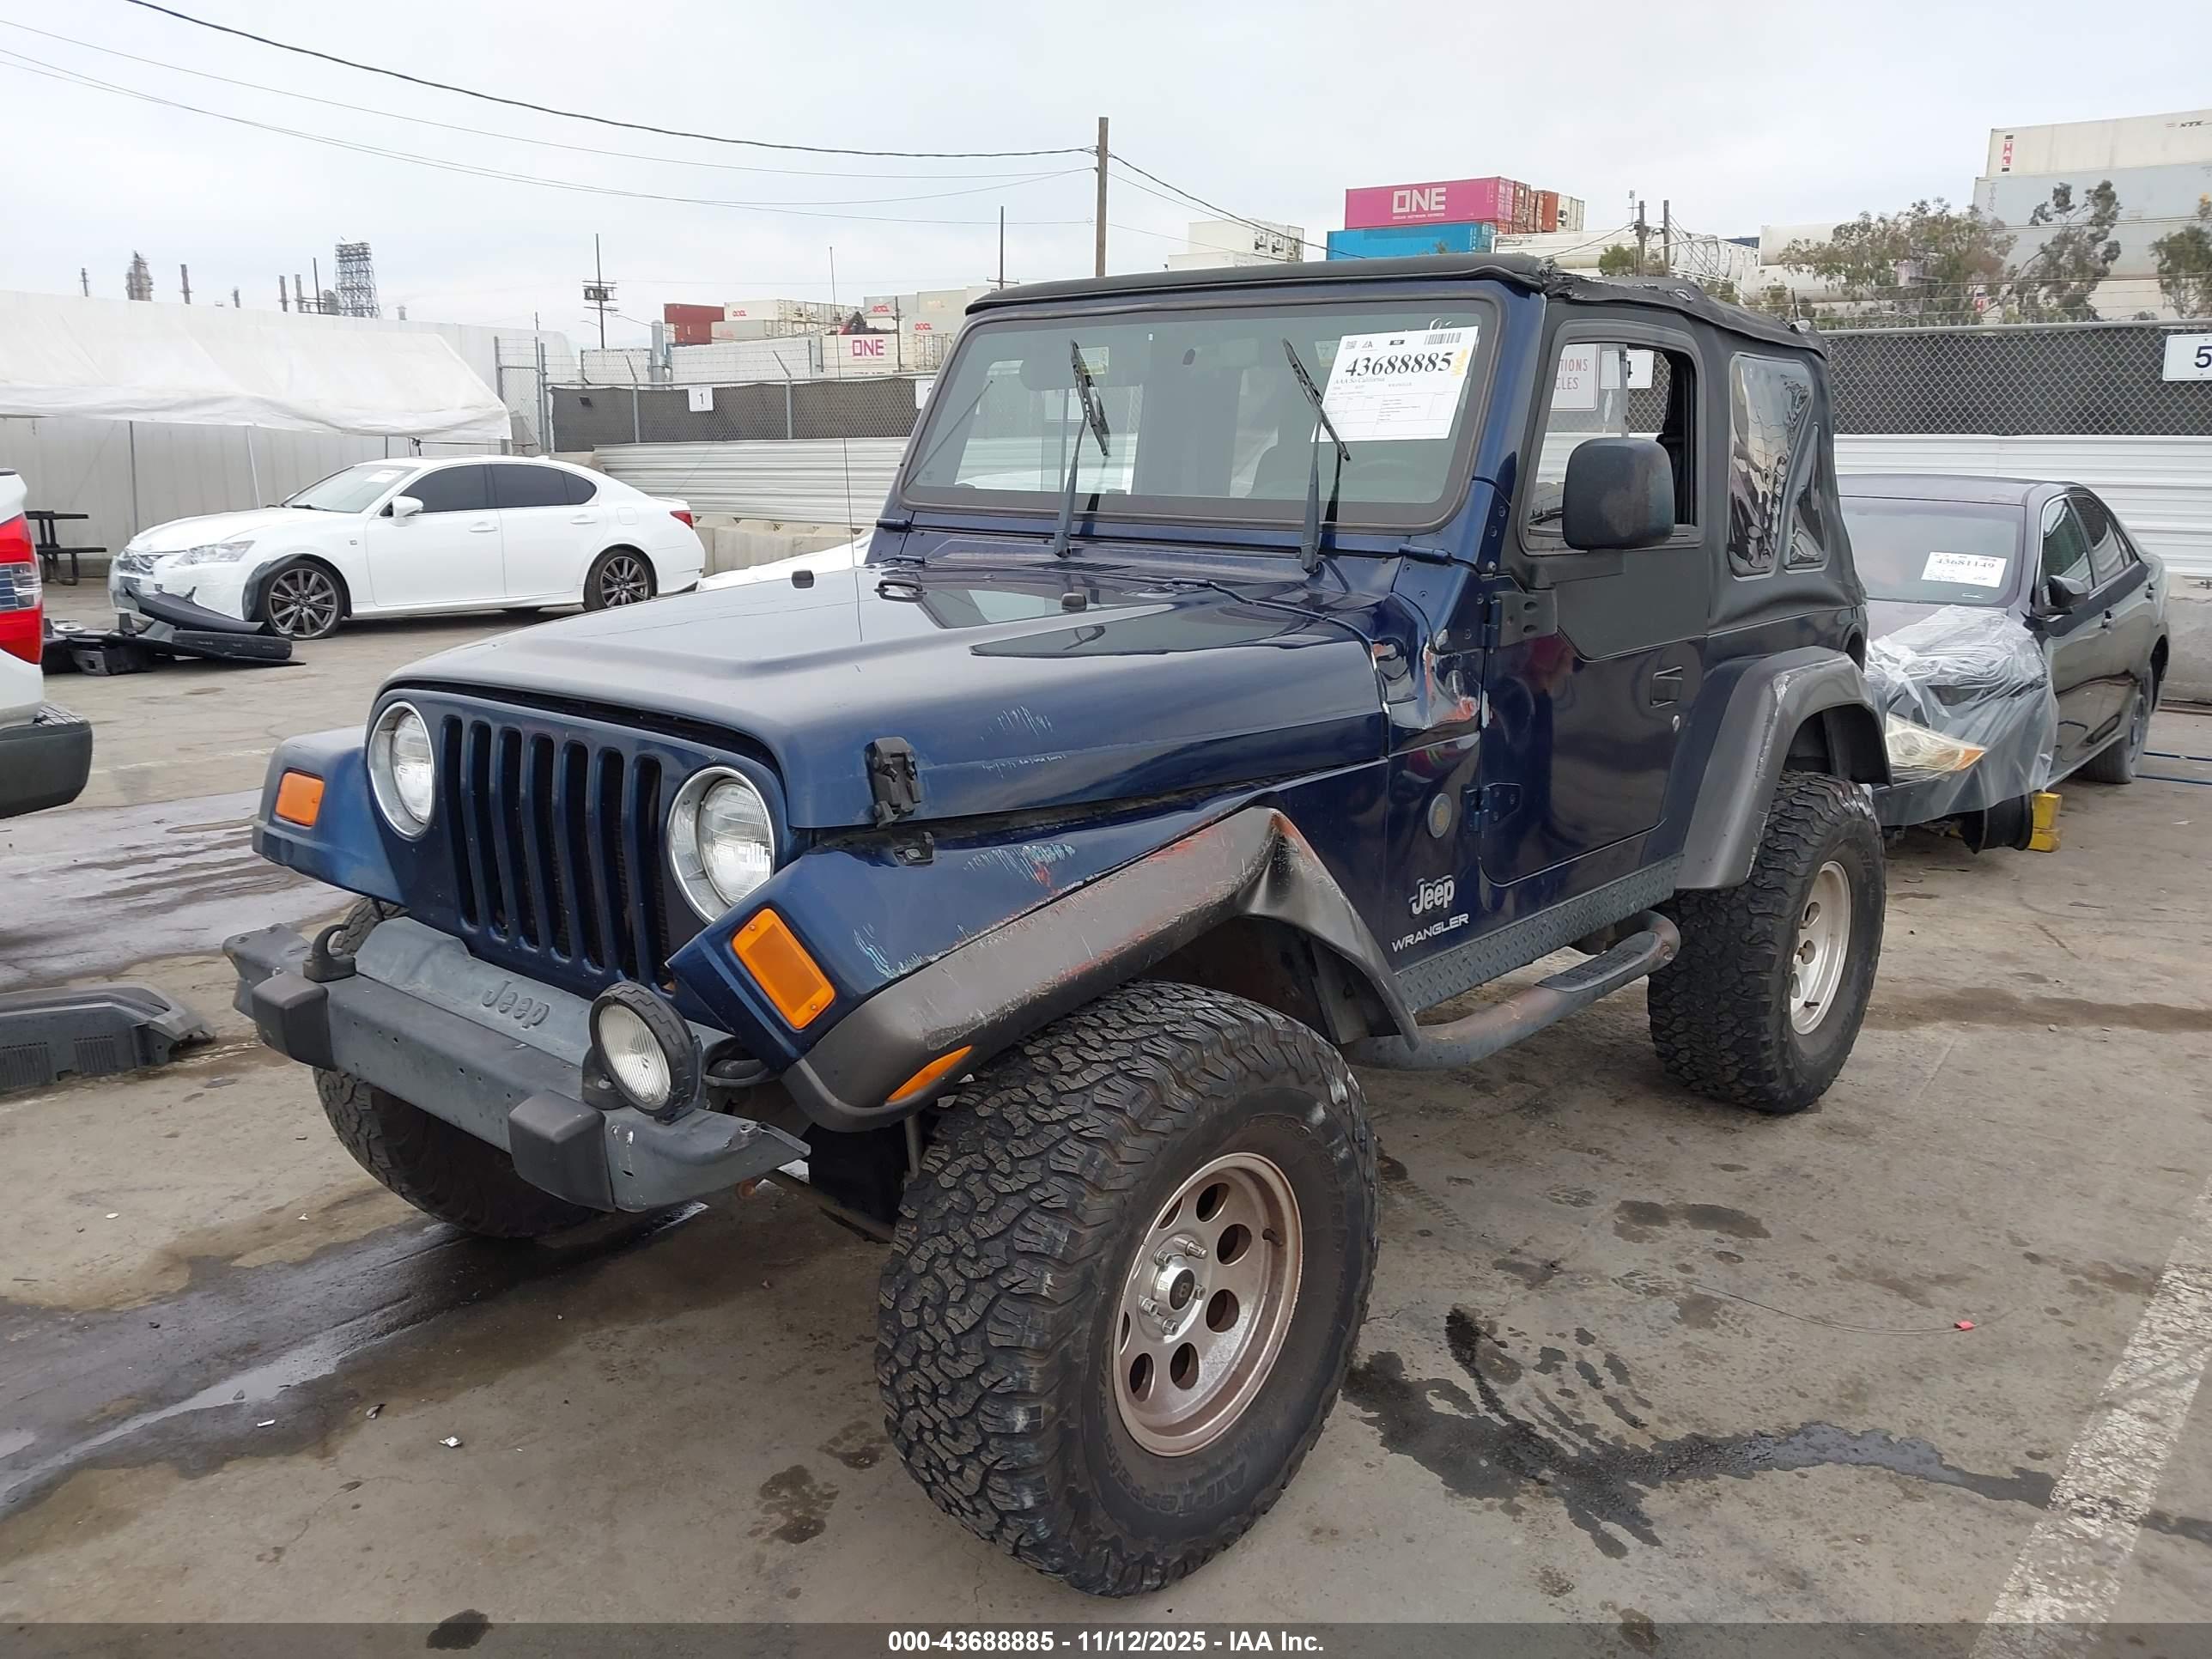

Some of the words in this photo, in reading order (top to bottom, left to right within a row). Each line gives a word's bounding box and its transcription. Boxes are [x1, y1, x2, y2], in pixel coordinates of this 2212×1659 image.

[1392, 187, 1447, 214] ONE
[852, 339, 884, 356] ONE
[2194, 345, 2212, 368] 5
[1345, 352, 1454, 376] 43688885
[699, 392, 704, 404] 1
[1936, 558, 1995, 568] 43681149
[1411, 878, 1455, 915] Jeep
[1391, 913, 1469, 952] WRANGLER
[481, 980, 550, 1030] Jeep
